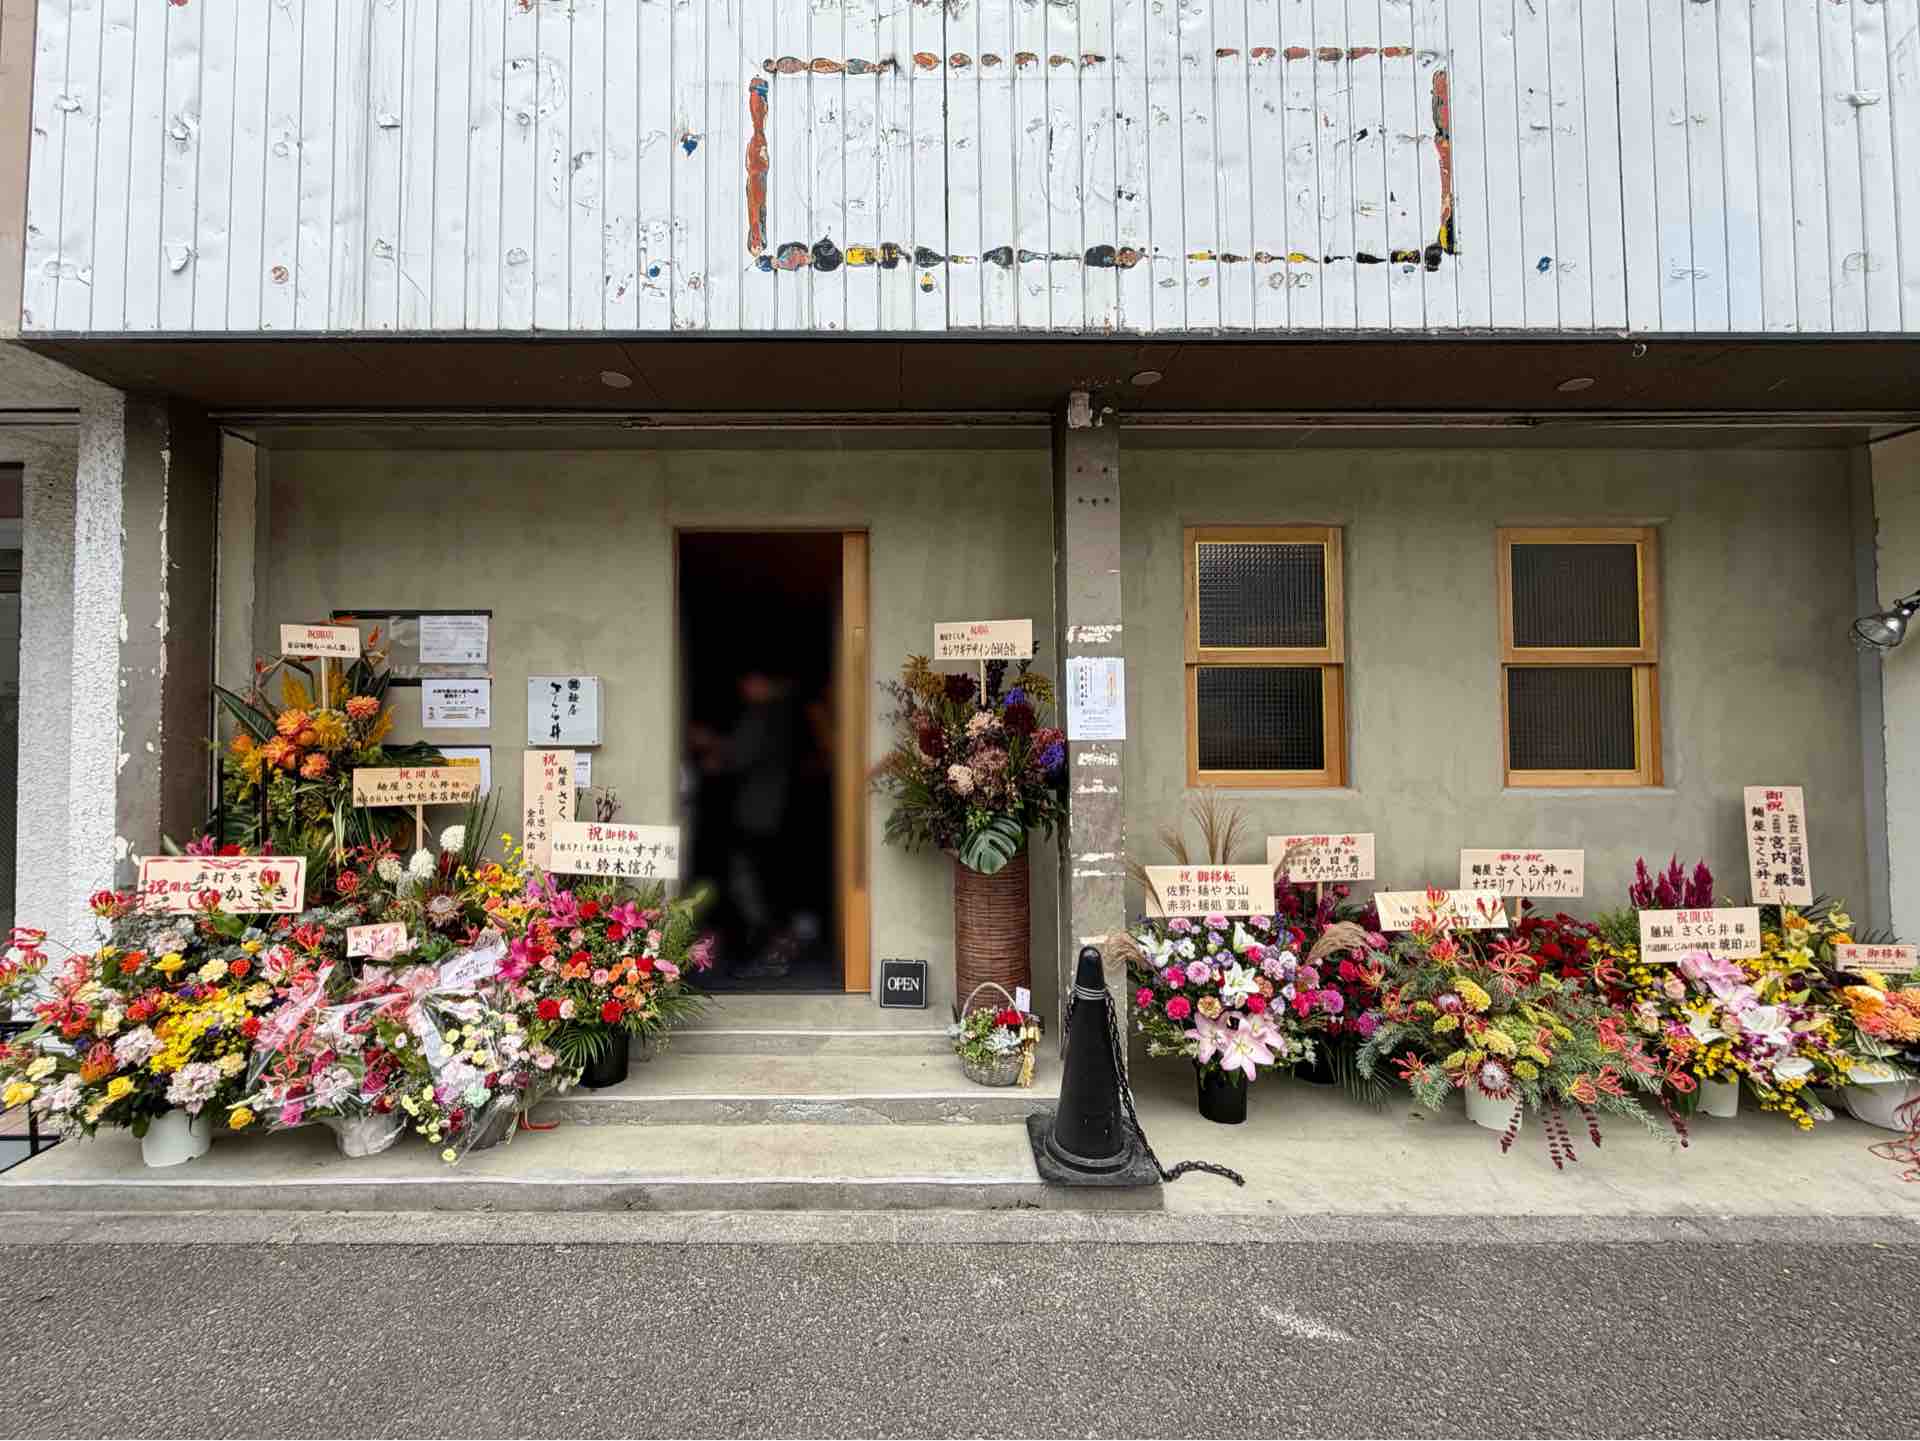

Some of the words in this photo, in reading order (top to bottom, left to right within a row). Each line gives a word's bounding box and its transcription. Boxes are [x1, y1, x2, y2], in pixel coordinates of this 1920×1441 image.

[1766, 791, 1784, 812] 御祝
[597, 858, 656, 876] 鈴木信介
[1311, 865, 1360, 873] YAMATO
[1197, 870, 1237, 882] 御移転
[1677, 911, 1714, 923] 祝開店
[887, 976, 920, 992] OPEN
